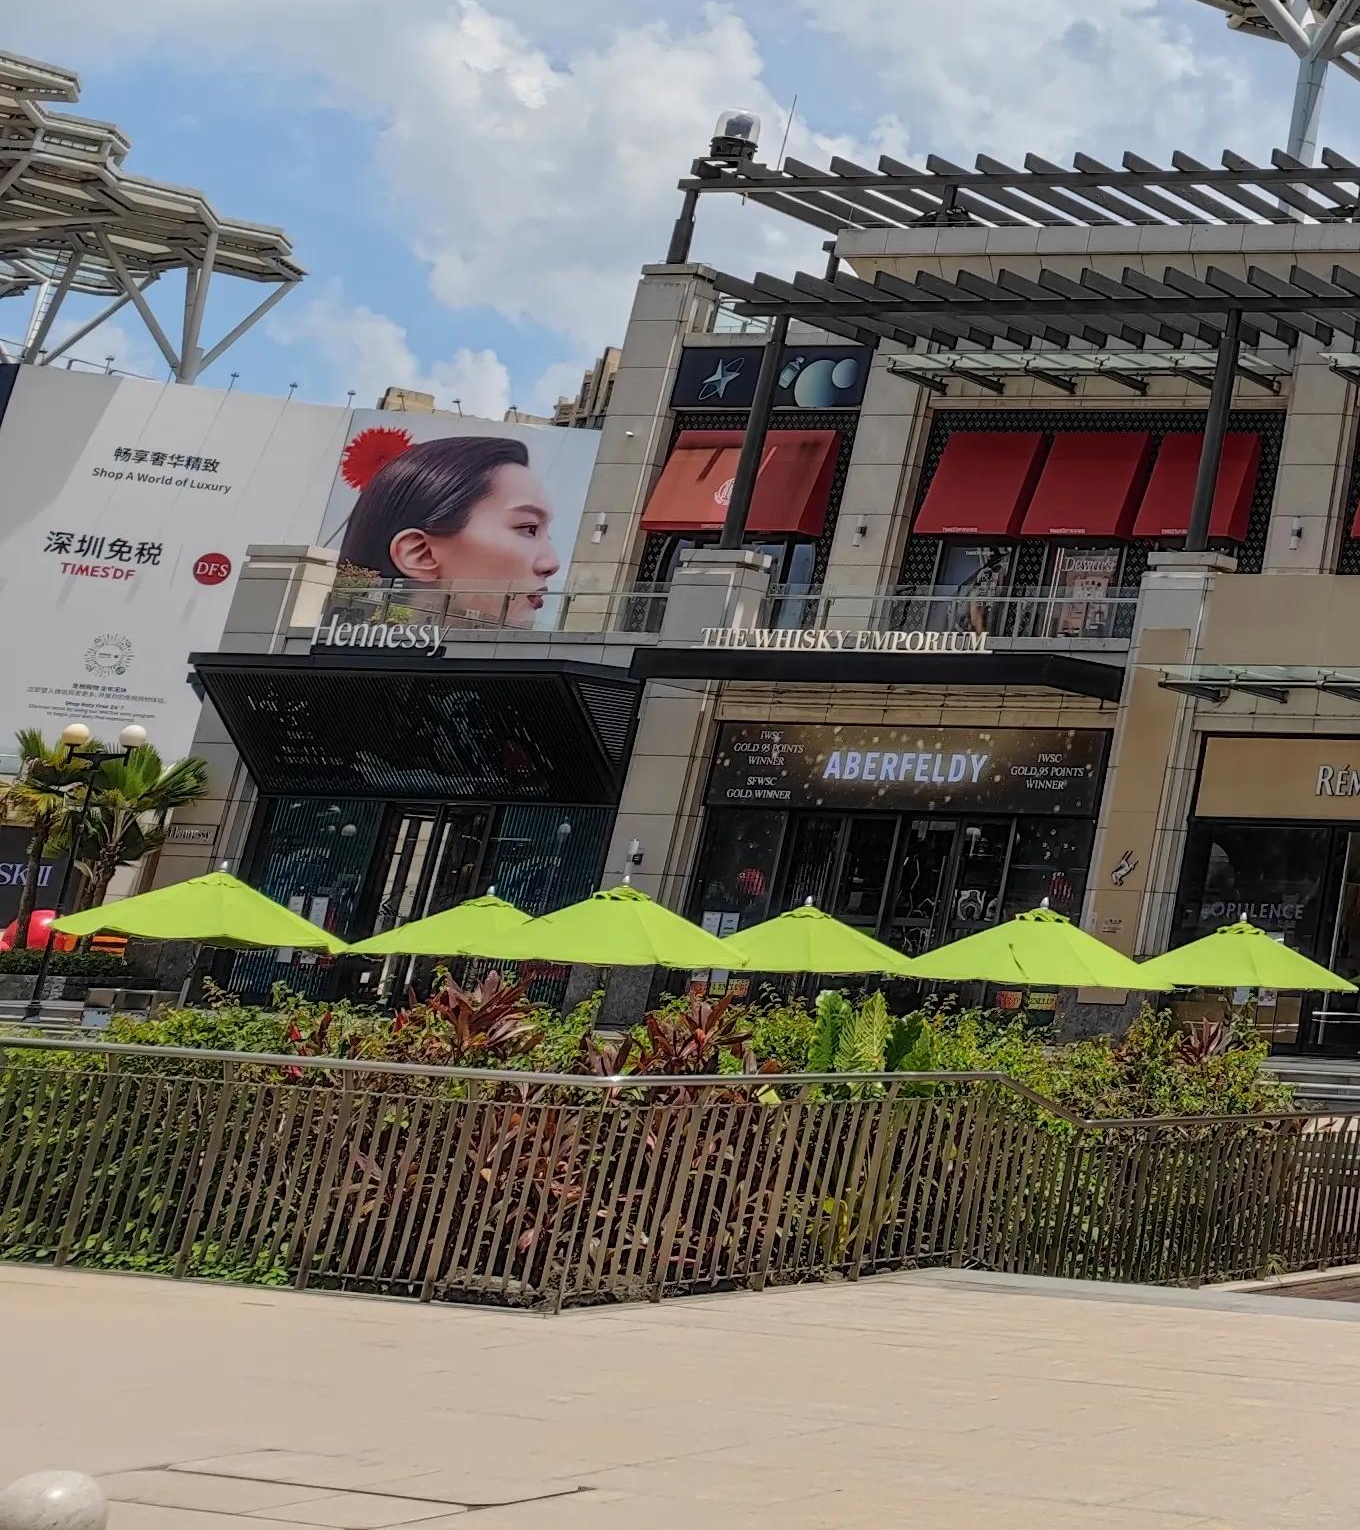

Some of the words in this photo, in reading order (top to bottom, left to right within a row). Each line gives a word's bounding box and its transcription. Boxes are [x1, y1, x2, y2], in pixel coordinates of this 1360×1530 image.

[114, 446, 220, 474] 畅享奢华精致
[91, 467, 123, 481] Shop
[125, 471, 134, 481] A
[137, 472, 173, 486] World
[175, 477, 188, 488] of
[190, 479, 232, 495] Luxury
[43, 530, 164, 566] 深圳免税
[196, 561, 229, 578] DFS
[310, 613, 451, 657] Hennessy
[701, 627, 749, 647] THE
[753, 628, 852, 649] WHISKY
[855, 630, 989, 652] EMPORIUM
[760, 731, 784, 741] IWSC
[733, 743, 760, 752] GOLD
[772, 744, 804, 754] POINTS
[748, 756, 785, 766] WINNER
[1037, 753, 1063, 763] IWSC
[822, 751, 989, 783] ABERFELDY
[1010, 766, 1038, 777] GOLD
[1050, 767, 1084, 777] POINTS
[1026, 779, 1065, 790] WINNER
[726, 789, 753, 799] GOLD
[754, 790, 791, 800] WINNER
[1210, 902, 1304, 919] OPULENCE
